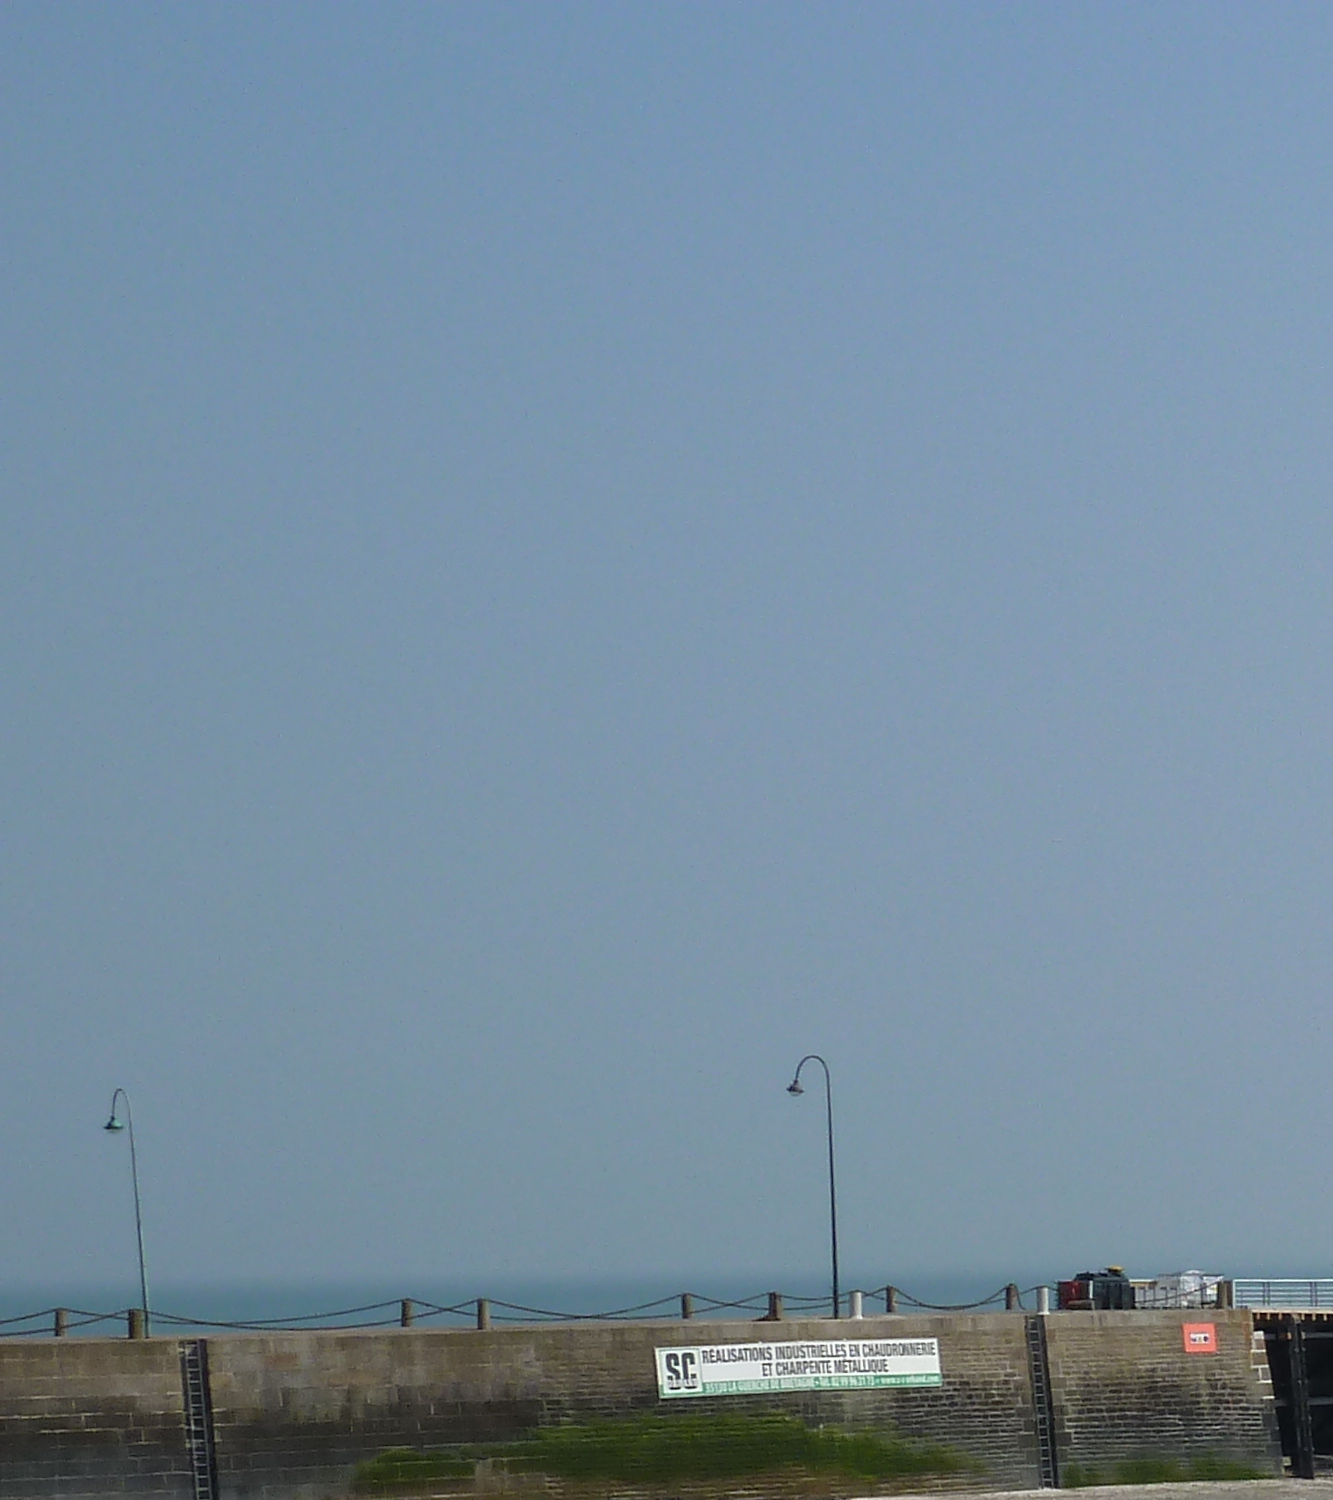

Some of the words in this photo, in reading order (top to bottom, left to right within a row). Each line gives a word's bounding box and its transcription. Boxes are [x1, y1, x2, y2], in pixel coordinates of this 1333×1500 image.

[702, 1346, 772, 1363] RÉALISATIONS
[775, 1343, 846, 1360] INDUSTRIELLES
[848, 1344, 860, 1357] EN
[862, 1342, 936, 1357] CHAUDRONNERIE
[762, 1363, 773, 1376] ET
[776, 1360, 832, 1375] CHARPENTE
[834, 1358, 889, 1374] MÉTALLIQUE
